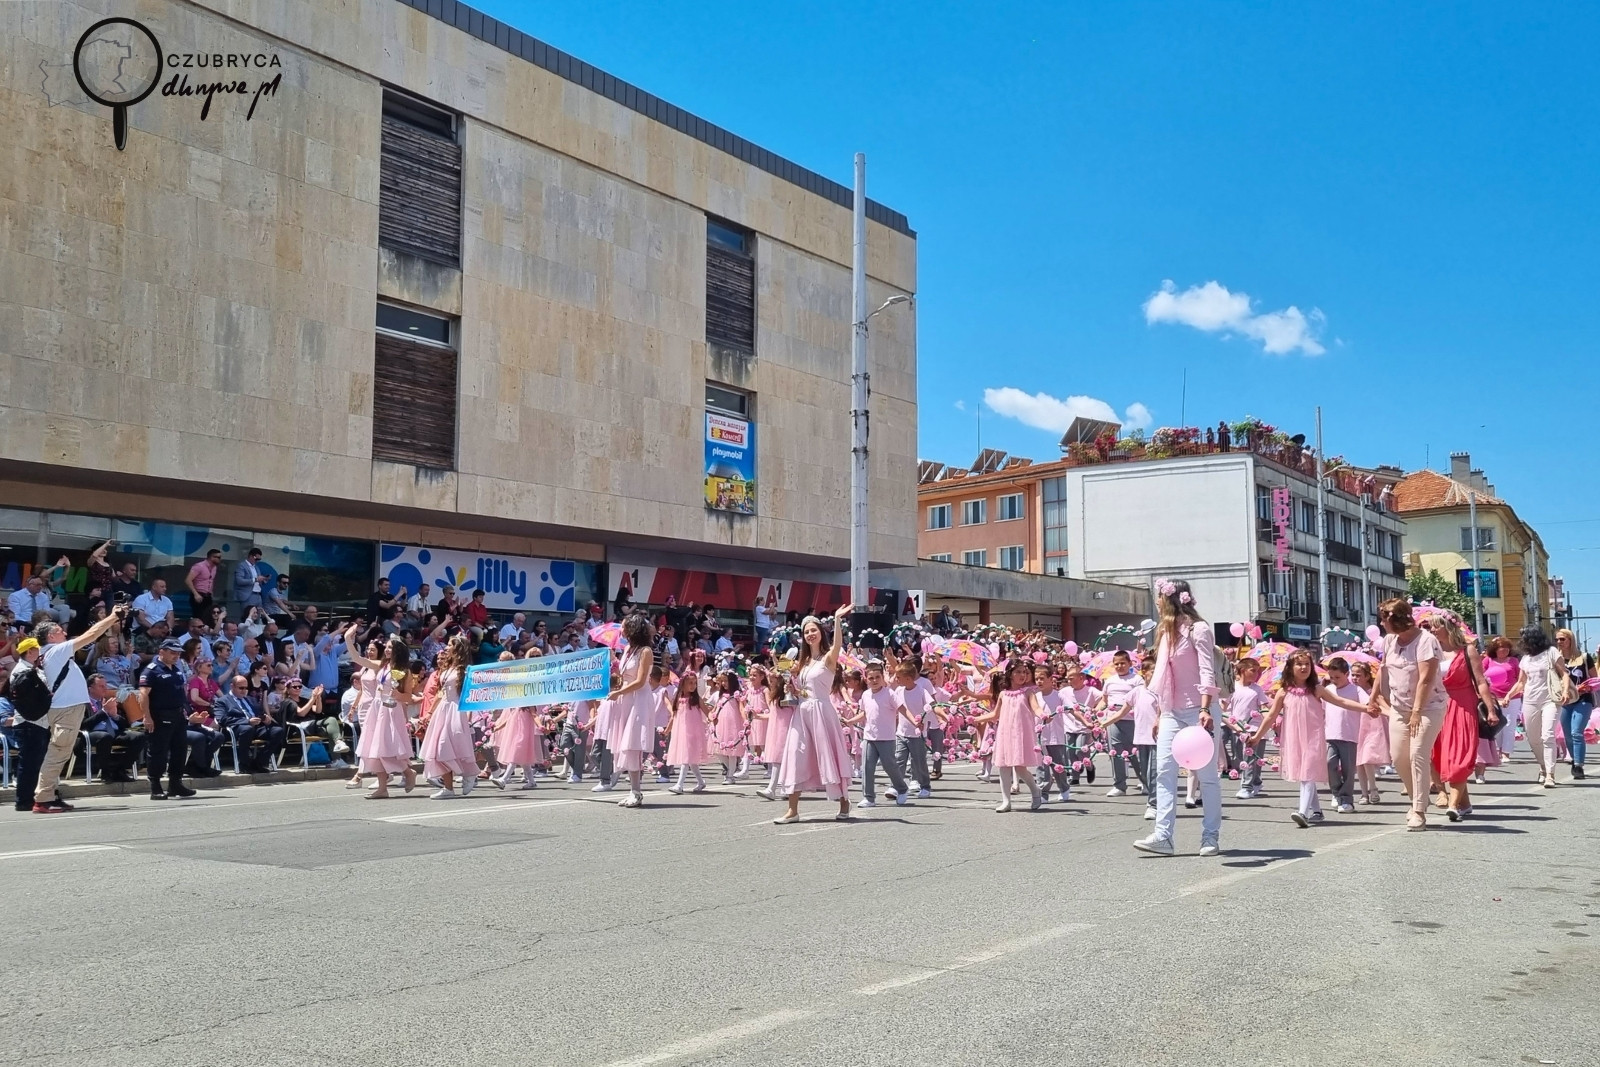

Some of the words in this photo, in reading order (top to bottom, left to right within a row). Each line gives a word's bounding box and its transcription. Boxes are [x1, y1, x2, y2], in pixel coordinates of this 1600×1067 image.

[713, 447, 743, 460] playmobil
[1273, 488, 1291, 571] HOTEL
[477, 557, 527, 605] lilly
[619, 568, 639, 597] A1
[766, 582, 783, 608] A1
[902, 594, 920, 617] A1
[538, 679, 557, 696] OVER
